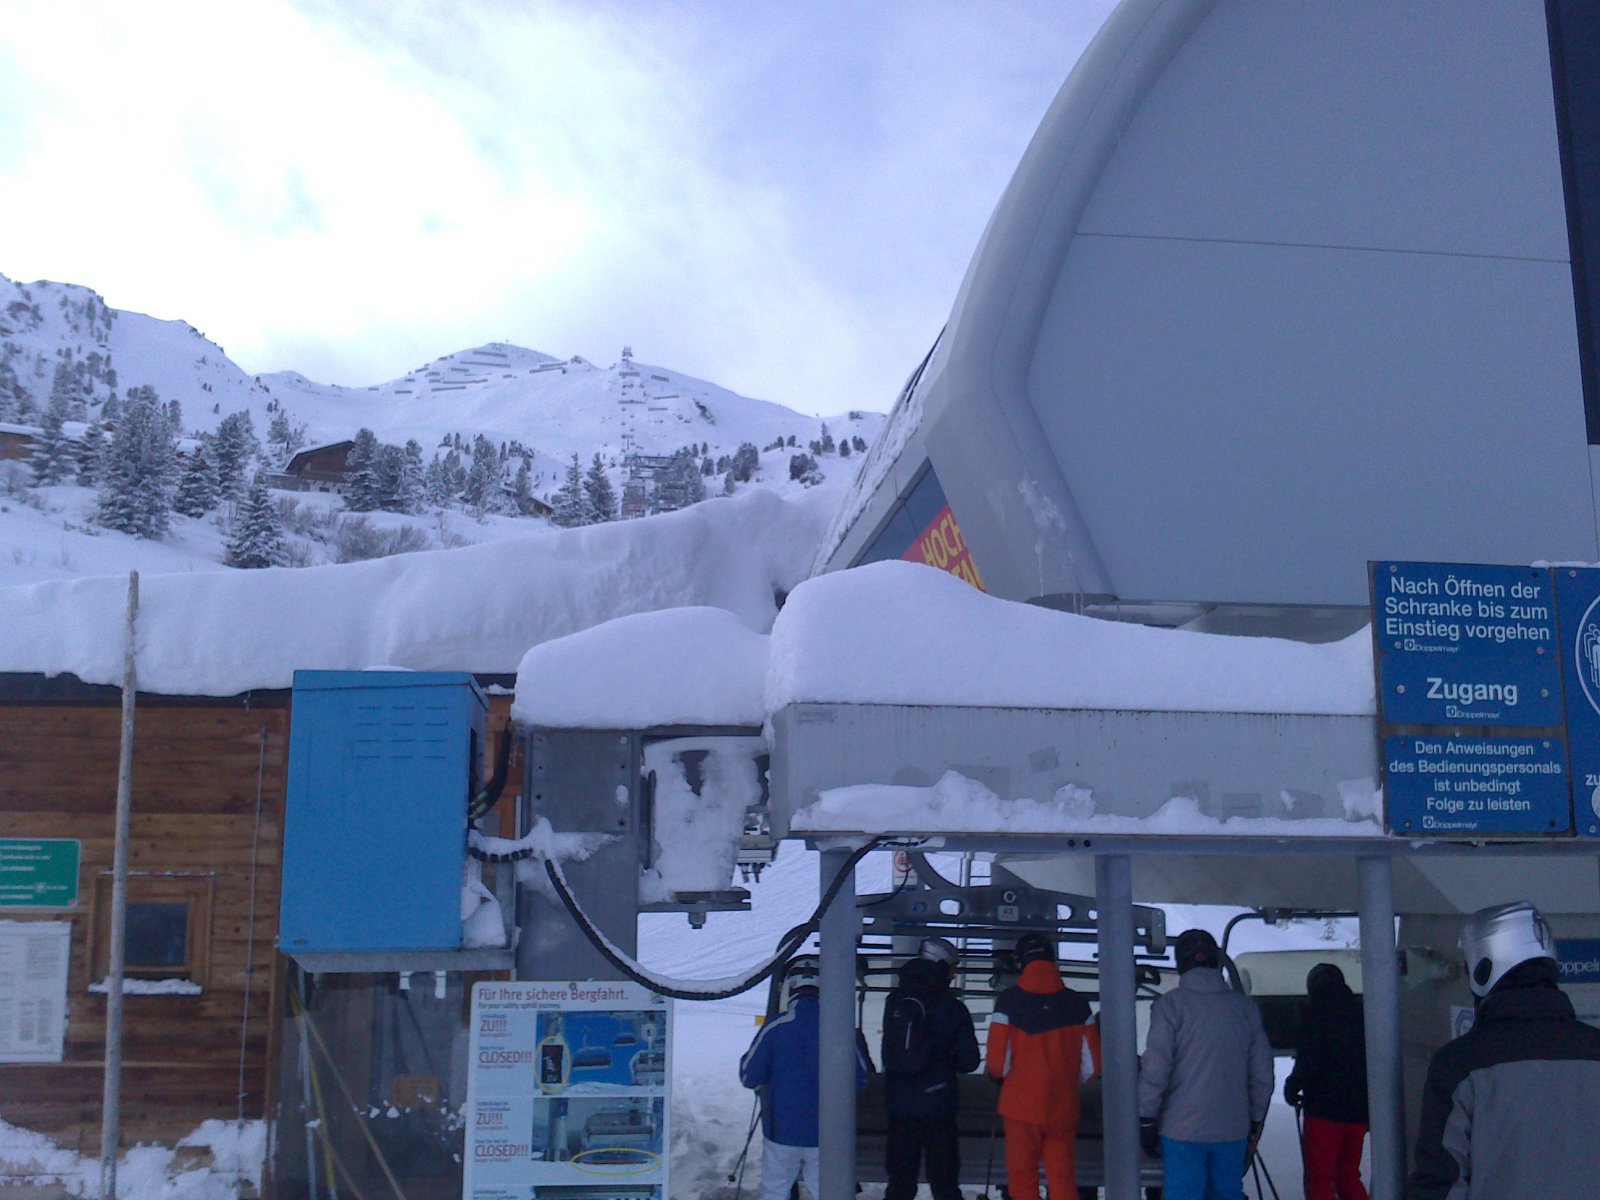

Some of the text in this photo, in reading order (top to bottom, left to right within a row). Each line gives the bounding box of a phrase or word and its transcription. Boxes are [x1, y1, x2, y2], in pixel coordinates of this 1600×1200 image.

[1391, 575, 1541, 598] Nach Öffnen der
[1385, 597, 1548, 620] Schranke bis zum
[1386, 618, 1550, 643] Einstieg vorgehen
[1426, 677, 1518, 706] Zugang
[1415, 741, 1534, 758] Den Anweisungen
[1389, 760, 1561, 776] des Bedienungspersonals
[1434, 779, 1521, 795] ist unbedingt
[1427, 797, 1531, 813] Folge zu leisten
[478, 988, 628, 1003] Für Ihre sichere Bergfahrt.
[478, 1051, 532, 1064] CLOSED!!!
[474, 1144, 529, 1157] CLOSED!!!
